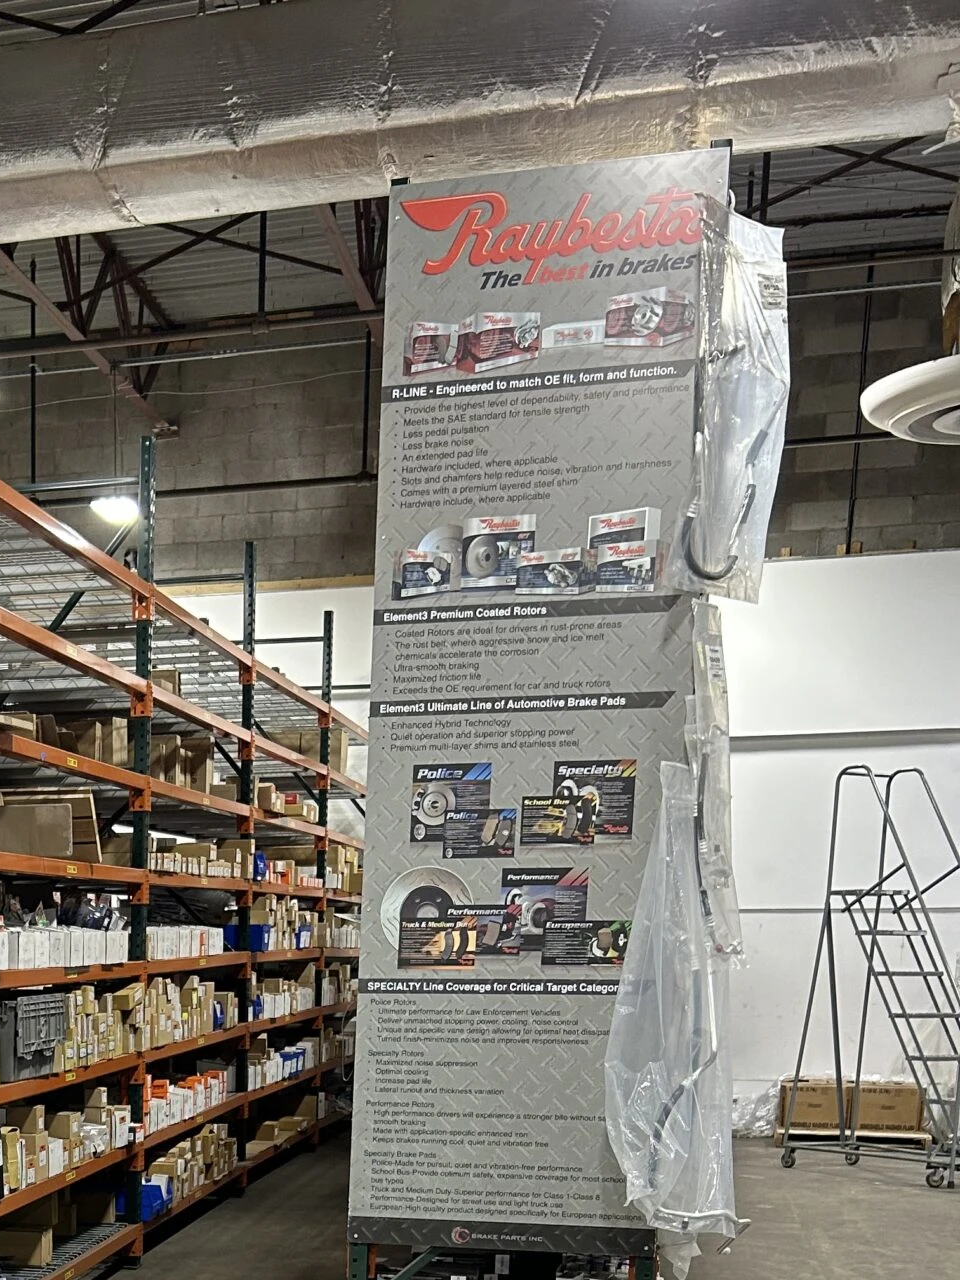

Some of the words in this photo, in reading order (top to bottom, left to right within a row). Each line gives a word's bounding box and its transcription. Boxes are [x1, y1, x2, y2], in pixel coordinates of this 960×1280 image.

[480, 270, 522, 290] The
[539, 262, 589, 285] best
[590, 259, 614, 278] in
[617, 253, 698, 276] brakes
[392, 385, 427, 399] R-LINE
[435, 380, 495, 396] Engineered
[496, 379, 508, 390] to
[509, 376, 542, 389] match
[544, 374, 561, 386] OE
[562, 373, 577, 385] fit,
[579, 372, 604, 383] form
[606, 369, 627, 380] and
[628, 366, 677, 379] function.
[402, 441, 423, 450] Less
[424, 439, 449, 448] brake
[450, 438, 474, 447] noise
[402, 453, 414, 462] An
[415, 450, 455, 461] extended
[456, 449, 474, 460] pad
[475, 448, 488, 457] life
[383, 610, 428, 622] Element3
[429, 610, 474, 620] Premium
[475, 607, 511, 618] Coated
[512, 607, 547, 616] Rotors
[379, 703, 425, 714] Element3
[426, 702, 469, 712] Ultimate
[470, 701, 492, 711] Line
[494, 700, 505, 710] of
[506, 699, 566, 710] Automotive
[567, 697, 598, 708] Brake
[599, 696, 626, 706] Pads
[391, 720, 433, 729] Enhanced
[434, 719, 462, 730] Hybrid
[463, 718, 511, 728] Technology
[390, 732, 413, 742] Quiet
[414, 731, 454, 742] operation
[455, 730, 472, 739] and
[473, 730, 508, 740] superior
[509, 729, 546, 739] stopping
[547, 729, 575, 738] power
[417, 767, 464, 780] Police
[558, 765, 624, 778] Specialty
[524, 798, 552, 806] School
[553, 798, 570, 806] Bus
[446, 811, 479, 820] Police
[507, 873, 559, 881] Performance
[447, 908, 506, 916] Performance
[546, 922, 593, 931] European
[367, 982, 421, 991] SPECIALTY
[422, 982, 444, 991] Line
[445, 982, 492, 993] Coverage
[493, 982, 508, 991] for
[509, 982, 544, 991] Critical
[546, 982, 577, 993] Target
[578, 982, 619, 993] Categor
[370, 998, 392, 1006] Police
[392, 998, 417, 1006] Rotors
[368, 1048, 400, 1058] Specialty
[400, 1049, 424, 1057] Rotors
[365, 1099, 410, 1108] Performance
[411, 1100, 435, 1108] Rotors
[363, 1149, 395, 1159] Specialty
[395, 1150, 417, 1158] Brake
[417, 1150, 437, 1158] Pads
